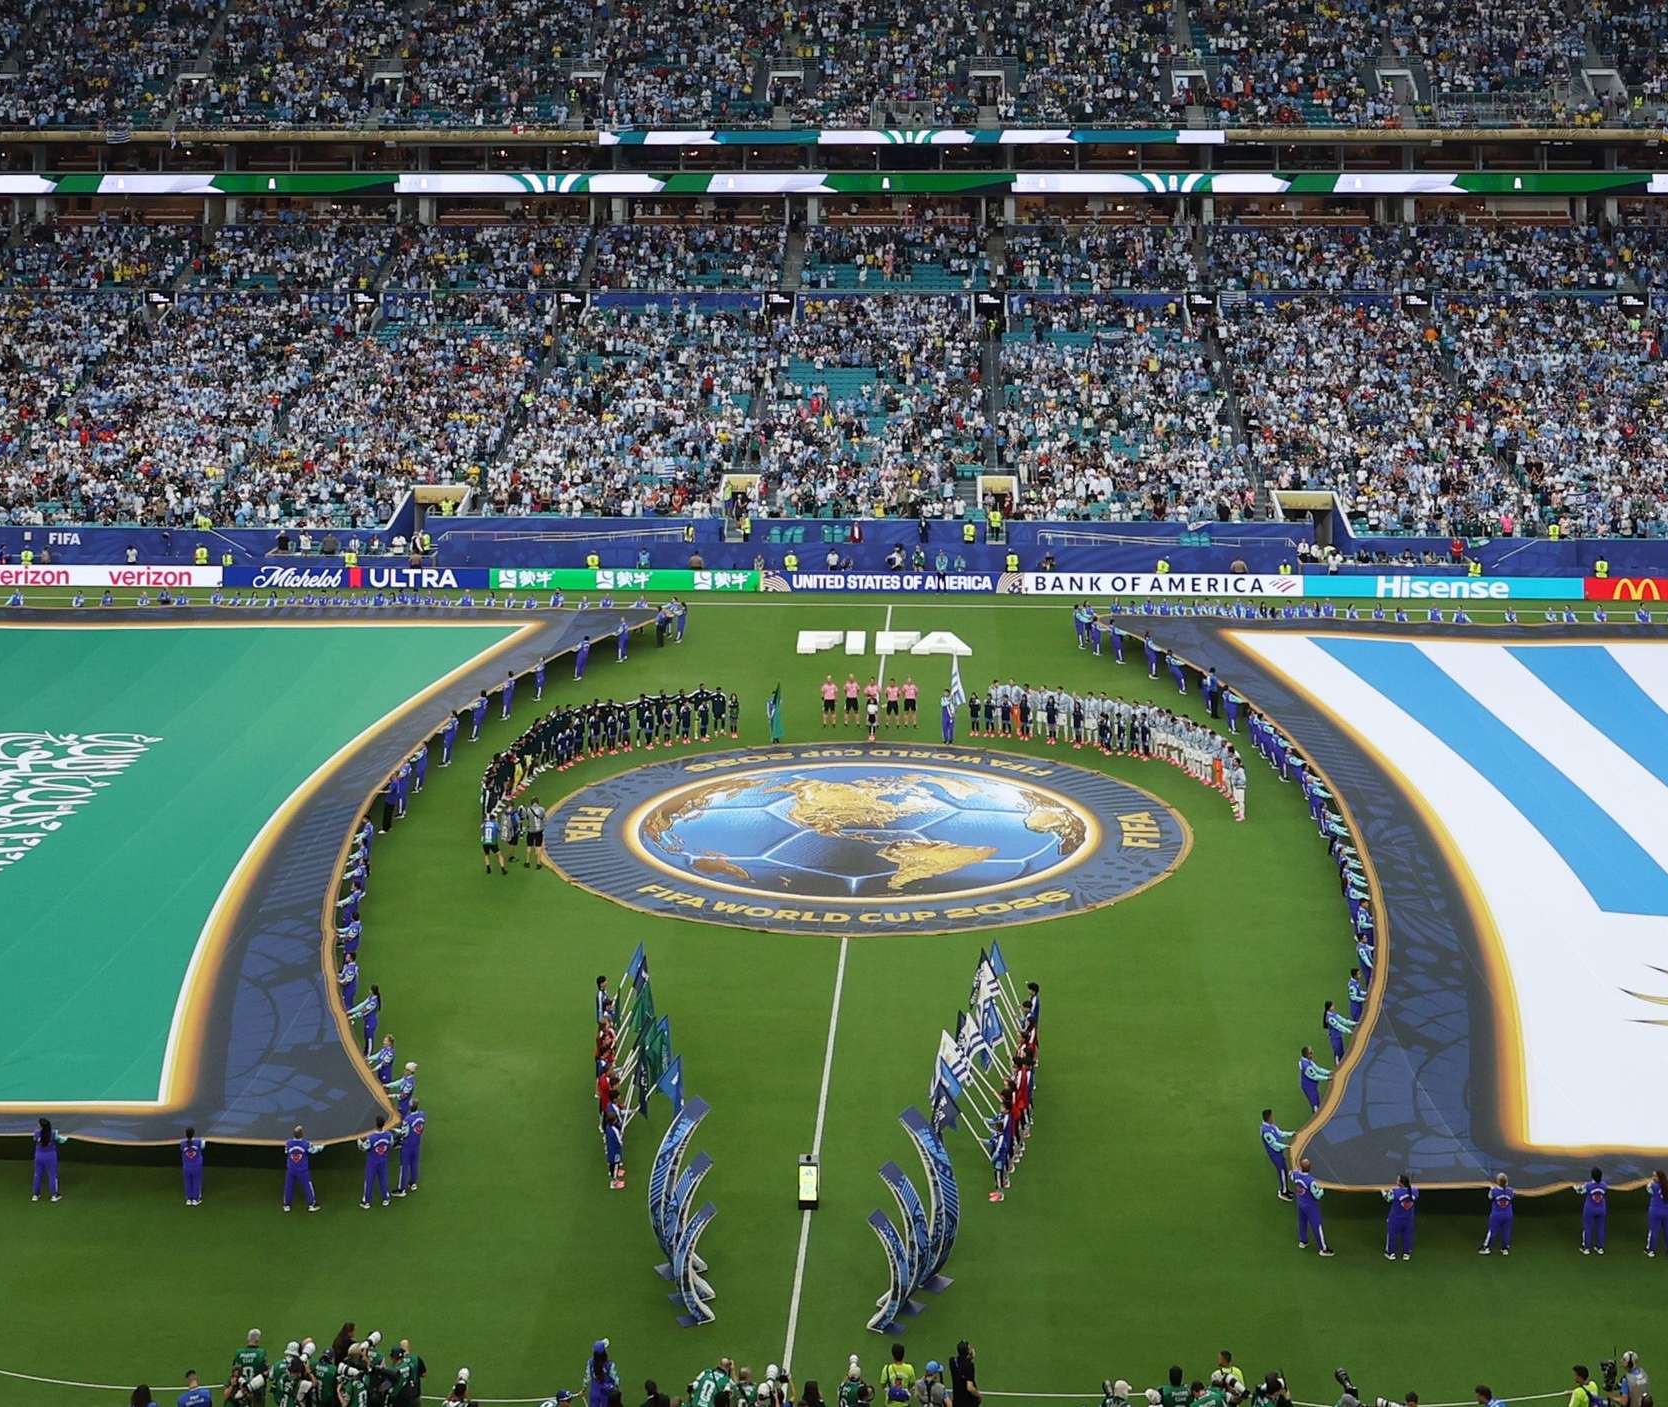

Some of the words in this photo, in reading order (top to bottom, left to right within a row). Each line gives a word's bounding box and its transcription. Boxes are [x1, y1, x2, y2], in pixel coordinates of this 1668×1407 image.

[49, 532, 81, 547] FIFA
[109, 565, 192, 587] verizon
[253, 566, 342, 589] Michelob
[369, 568, 458, 589] ULTRA
[519, 569, 553, 590] 蒙牛
[616, 570, 649, 590] 蒙牛
[714, 571, 748, 591] 蒙牛
[792, 575, 845, 591] UNITED
[847, 575, 899, 592] STATES
[901, 575, 922, 592] OF
[1035, 575, 1100, 592] BANK
[1110, 576, 1141, 593] OF
[1150, 577, 1264, 594] AMERICA
[1377, 576, 1510, 599] Hisense
[796, 630, 973, 657] FIFA
[684, 752, 795, 772] 2026
[801, 749, 863, 758] CUP
[870, 749, 982, 764] WORLD
[990, 759, 1053, 777] FIFA
[566, 806, 613, 843] FIFA
[1122, 810, 1160, 849] FIFA
[636, 884, 705, 910] FIFA
[709, 903, 851, 922] WORLD
[859, 909, 936, 923] CUP
[943, 889, 1072, 919] 2026
